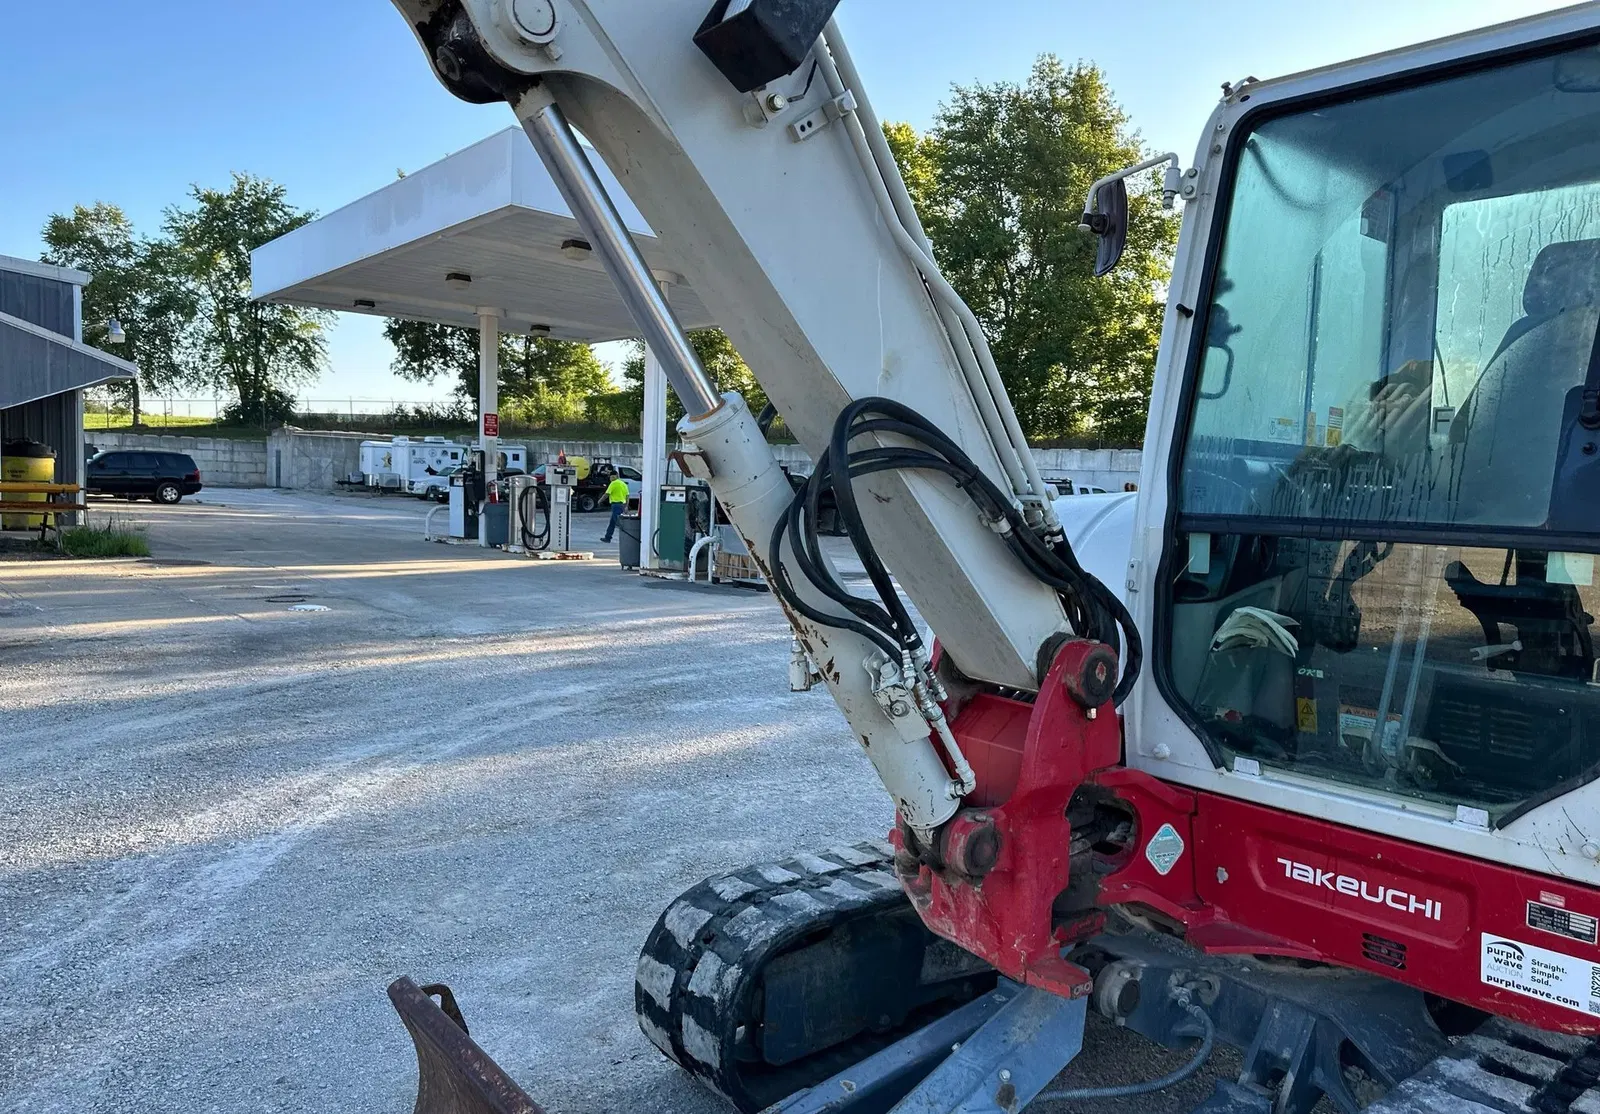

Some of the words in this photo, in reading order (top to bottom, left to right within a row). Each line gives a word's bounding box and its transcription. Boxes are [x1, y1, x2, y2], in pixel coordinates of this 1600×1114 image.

[1487, 946, 1523, 961] purple
[1487, 963, 1523, 978] AUCTION
[1493, 956, 1523, 970] wave
[1531, 959, 1567, 974] Straight.
[1531, 967, 1562, 982] Simple.
[1531, 976, 1552, 987] Sold.
[1487, 974, 1580, 1007] purplewave.com
